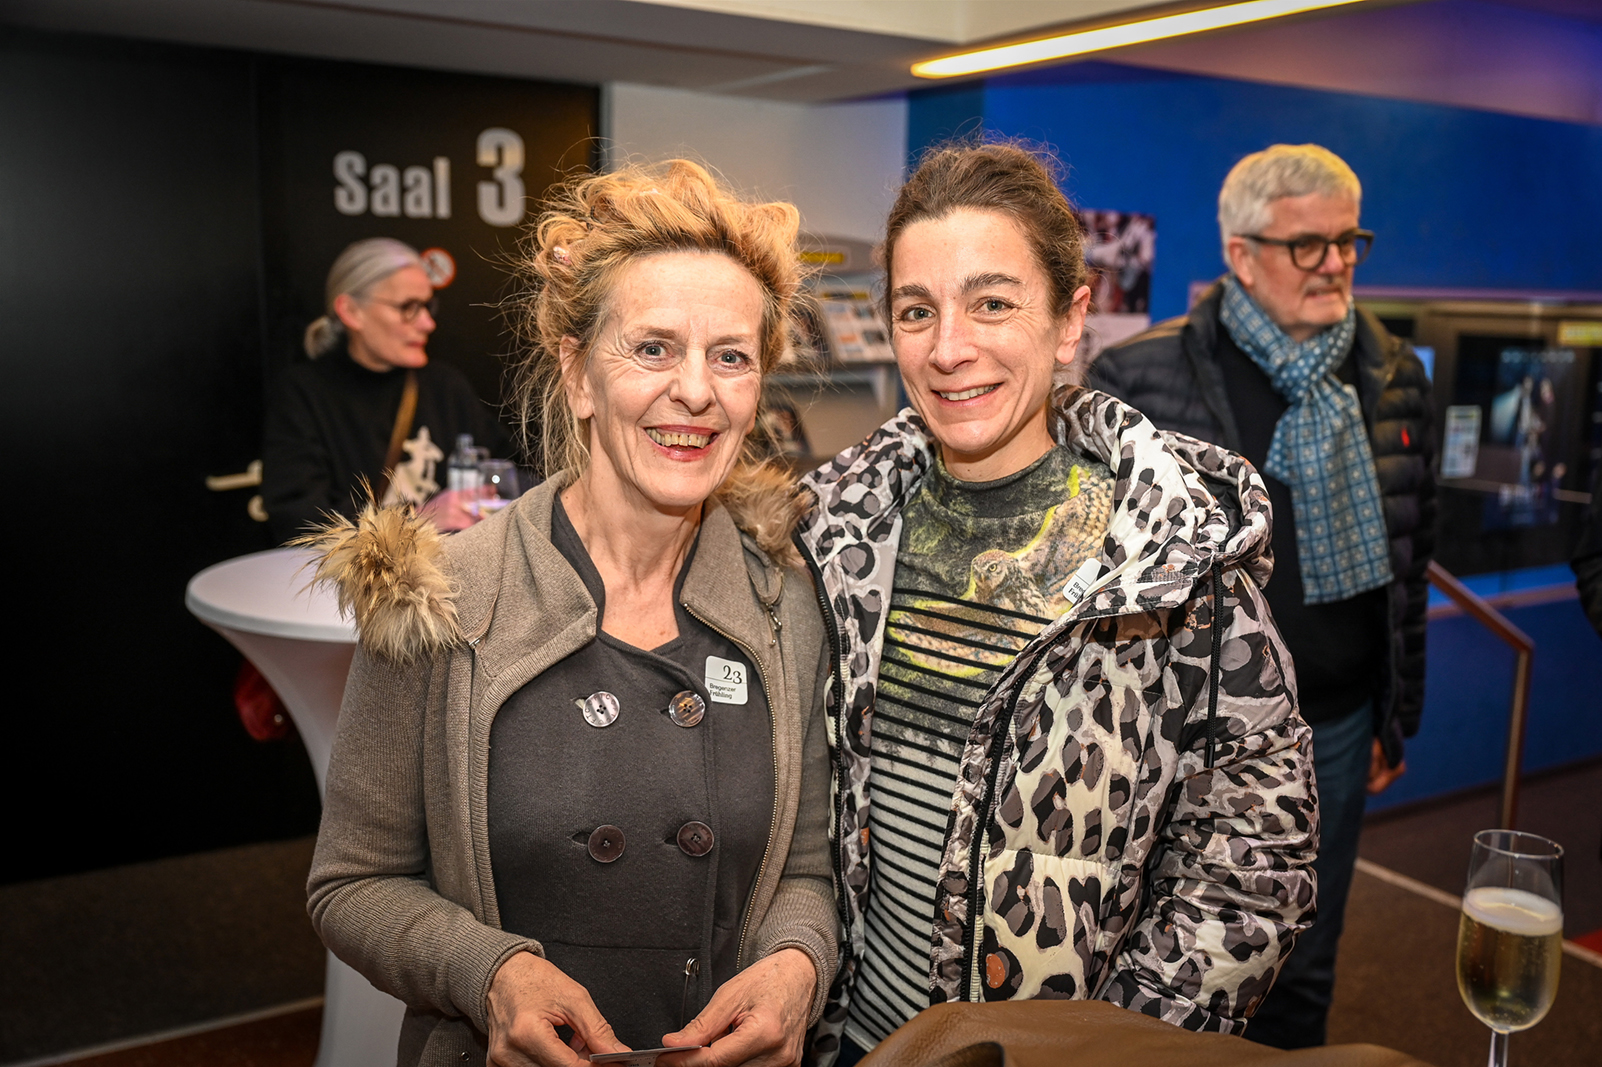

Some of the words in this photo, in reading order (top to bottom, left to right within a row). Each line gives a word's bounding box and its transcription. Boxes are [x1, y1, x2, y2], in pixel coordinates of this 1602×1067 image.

[333, 150, 452, 219] Saal
[475, 127, 526, 227] 3
[723, 665, 742, 684] 23
[710, 683, 736, 692] Bregenzer
